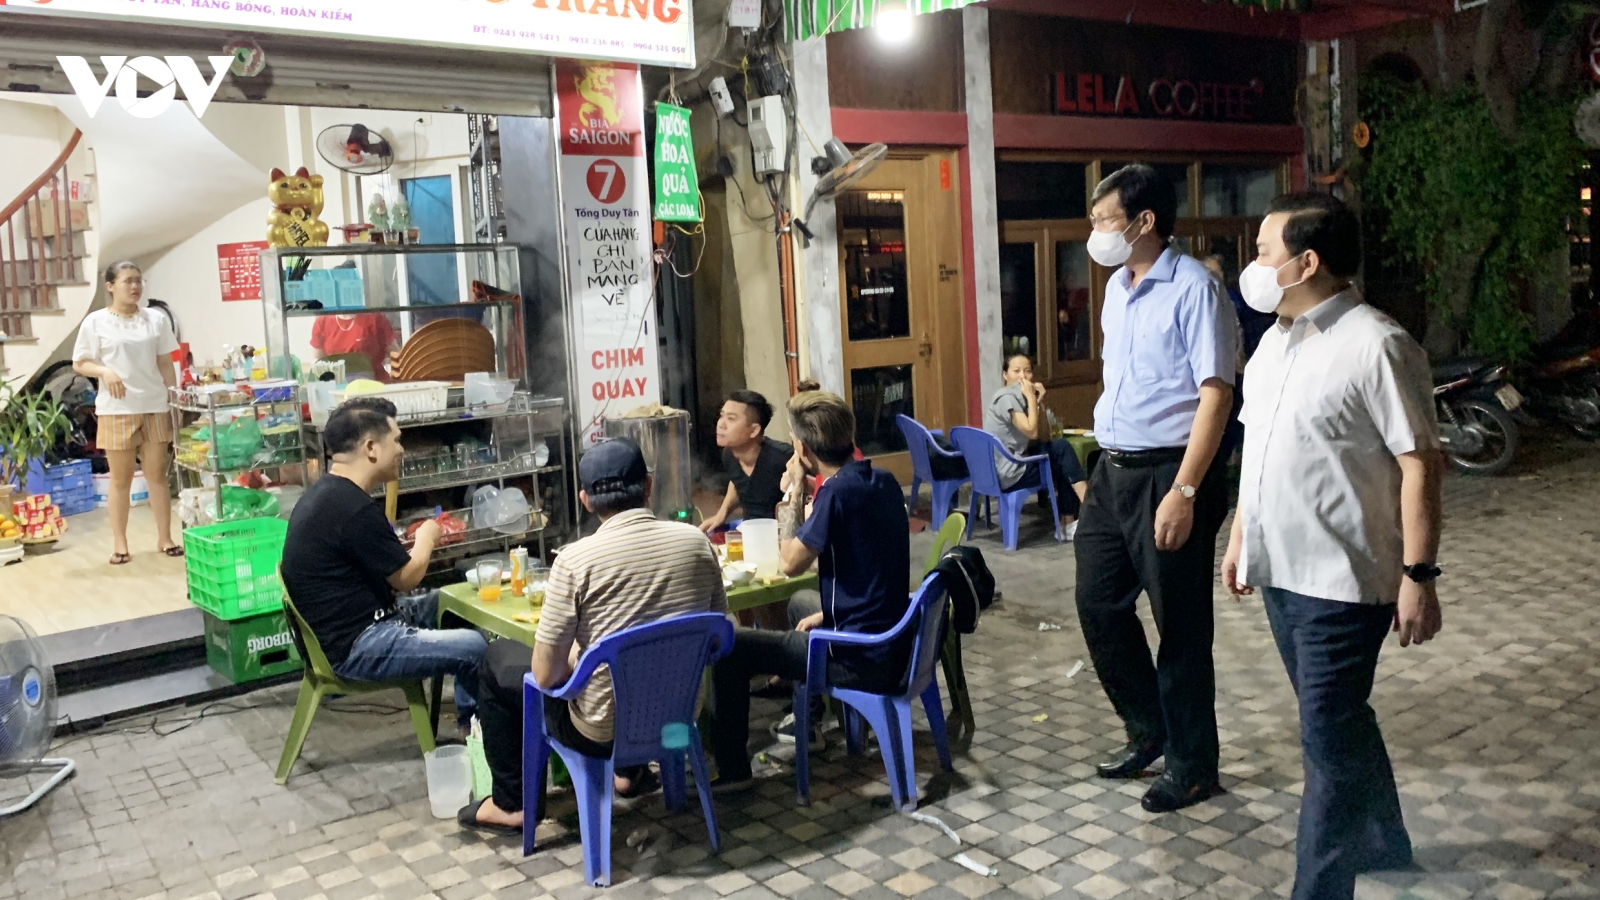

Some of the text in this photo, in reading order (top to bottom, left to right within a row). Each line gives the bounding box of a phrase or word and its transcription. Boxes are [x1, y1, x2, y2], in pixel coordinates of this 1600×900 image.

[281, 6, 316, 17] HOÀN
[321, 8, 352, 21] KIẾM
[493, 28, 516, 37] 0243
[1056, 71, 1252, 120] LELA COFFEE
[590, 119, 609, 129] BIA
[658, 110, 688, 138] NƯỚC
[569, 128, 631, 146] SAIGON
[661, 142, 689, 165] HOA
[594, 165, 616, 200] 7
[662, 168, 689, 196] QUẢ
[602, 208, 620, 219] Duy
[622, 207, 639, 217] Tân
[613, 221, 640, 242] HÀNG
[587, 274, 638, 289] MANG
[601, 287, 627, 306] VỀ
[591, 347, 644, 370] CHIM
[592, 377, 648, 401] QUAY
[247, 631, 294, 654] UBORG
